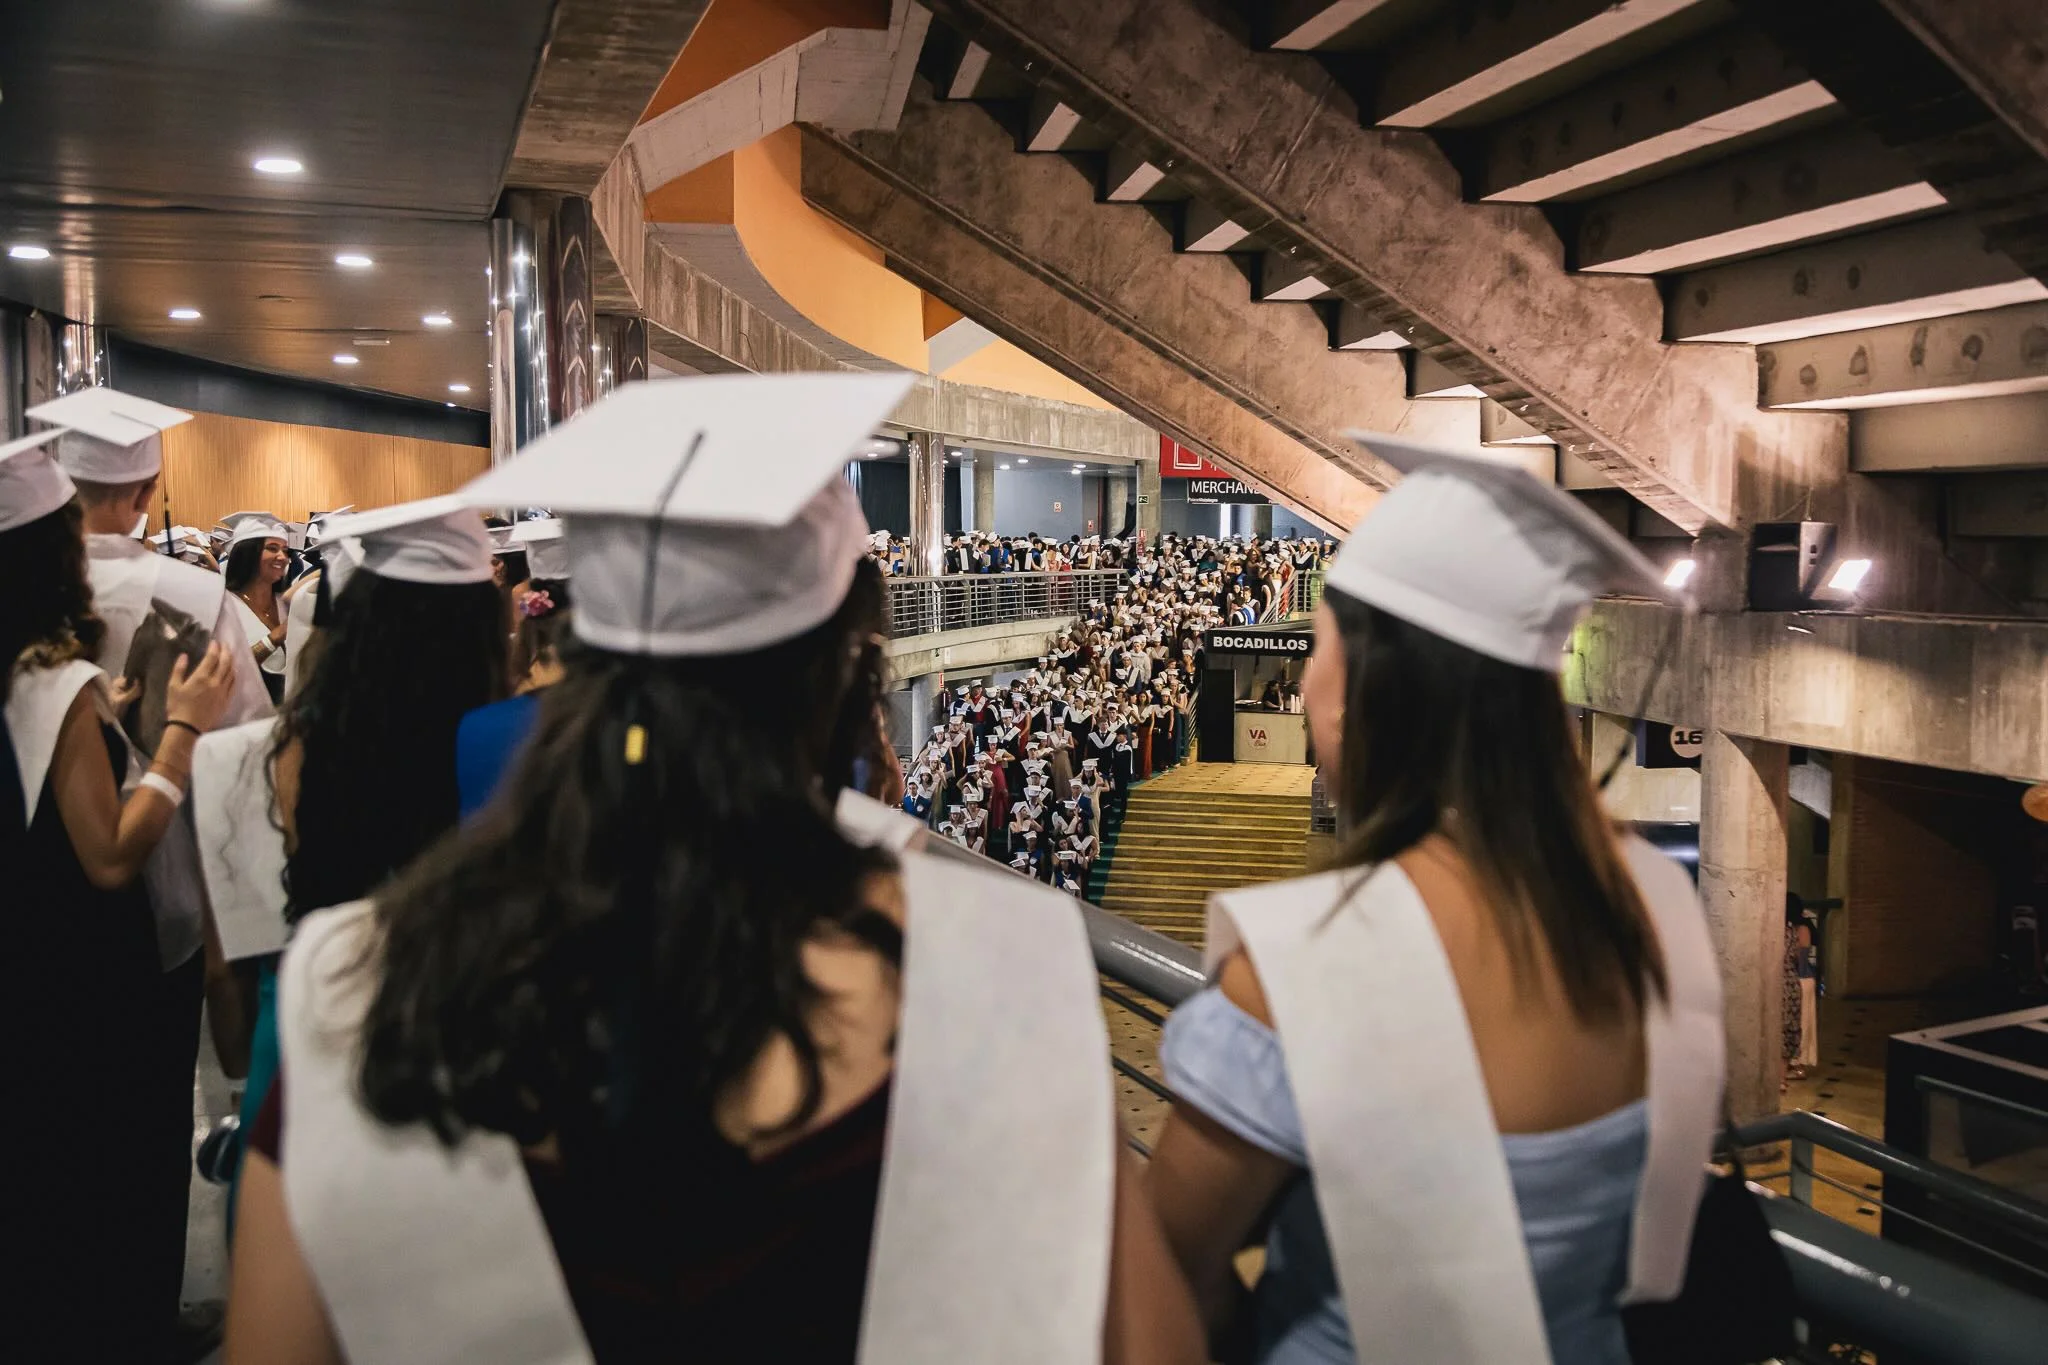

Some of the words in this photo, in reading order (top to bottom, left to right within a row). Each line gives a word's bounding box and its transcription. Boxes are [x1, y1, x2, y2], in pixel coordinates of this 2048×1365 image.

[1191, 481, 1260, 494] MERCHAN
[1213, 636, 1308, 651] BOCADILLOS
[1249, 729, 1267, 740] VA
[1674, 731, 1703, 745] 16
